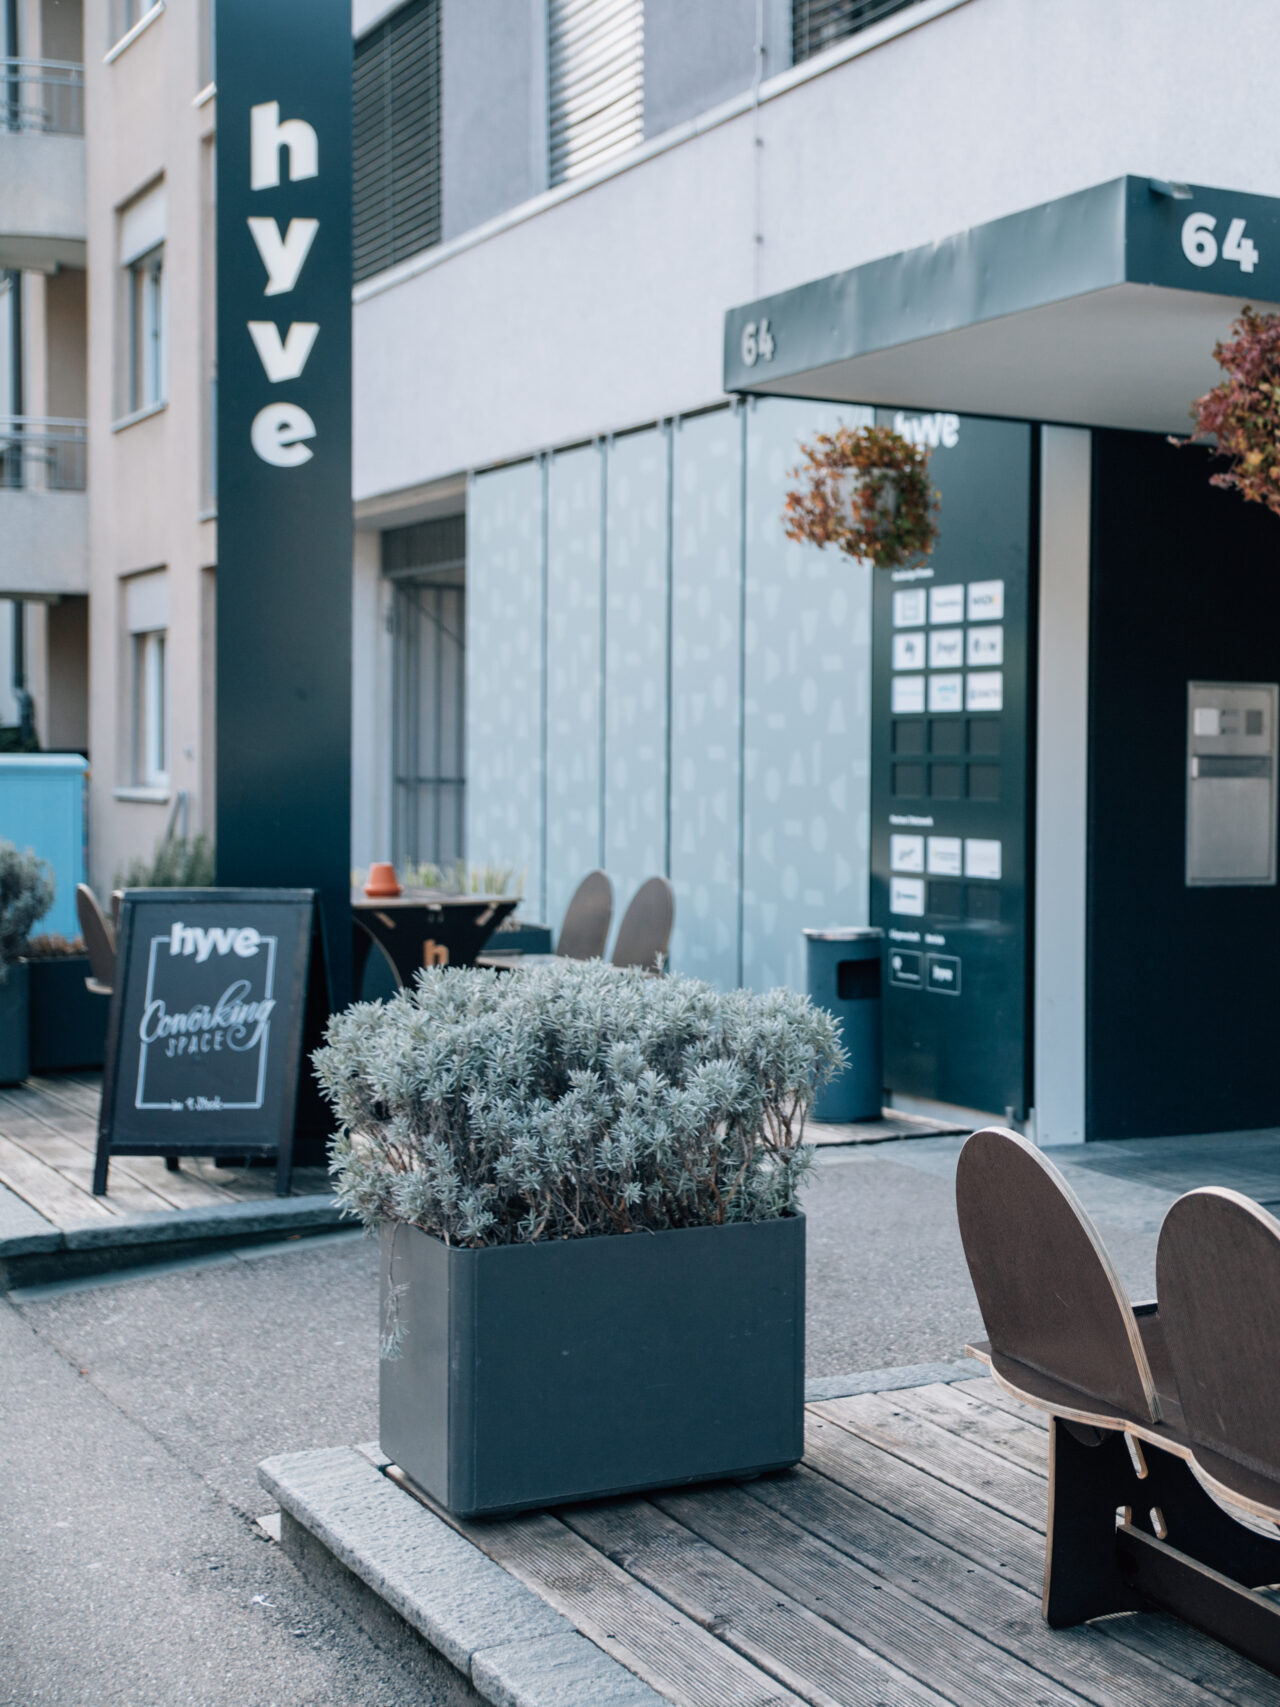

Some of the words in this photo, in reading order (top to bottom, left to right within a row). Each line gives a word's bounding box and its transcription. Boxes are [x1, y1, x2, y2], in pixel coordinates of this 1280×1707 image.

[1180, 210, 1259, 274] 64
[246, 100, 320, 468] hyve
[740, 319, 775, 368] 64
[169, 920, 261, 963] hyve
[165, 1030, 224, 1058] SPACE
